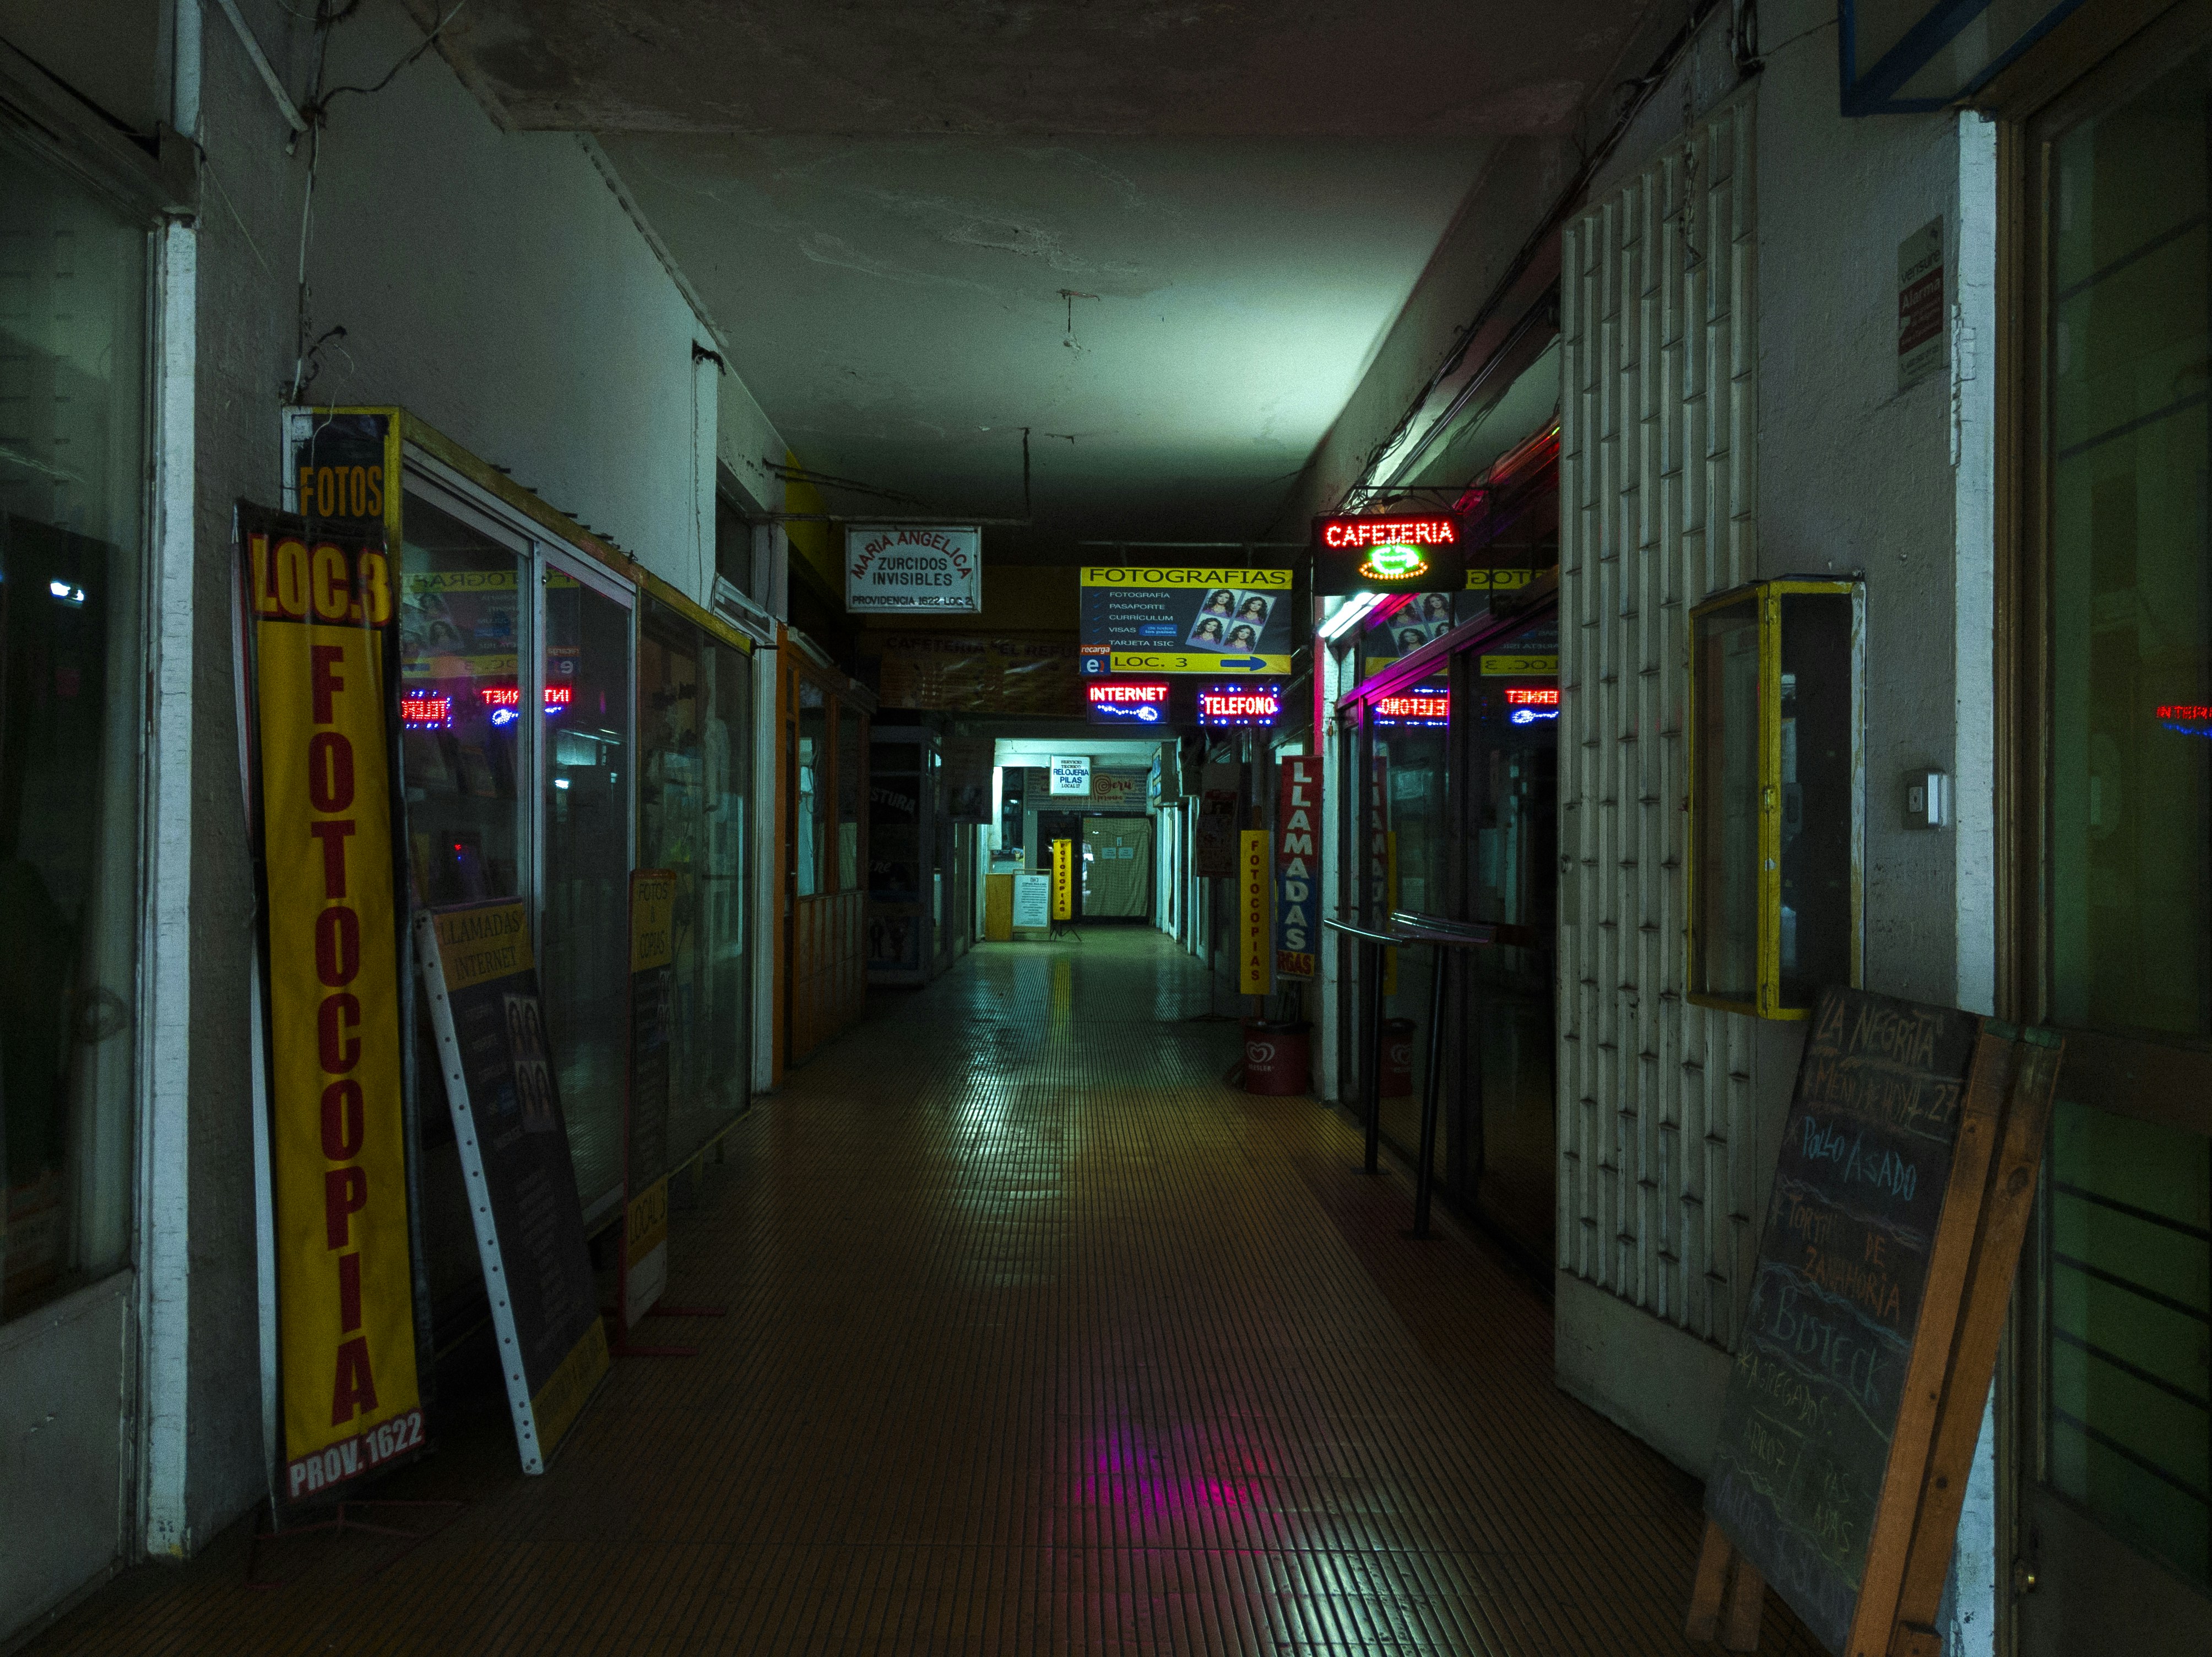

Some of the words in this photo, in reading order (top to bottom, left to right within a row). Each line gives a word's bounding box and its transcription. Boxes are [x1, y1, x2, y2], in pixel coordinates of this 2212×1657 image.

[1902, 278, 1940, 312] Alarma
[300, 466, 382, 517] FOTOS
[1326, 522, 1454, 547] CAFETERIA
[852, 535, 892, 580] MARIA
[897, 530, 972, 580] ANGELICA
[879, 557, 947, 571] ZURCIDOS
[872, 573, 952, 586] INVISIBLES
[1089, 568, 1286, 584] FOTOGRAFIAS
[852, 596, 915, 605] PROVIDENCIA
[918, 597, 940, 605] 1622
[886, 637, 985, 654] CAFETERIA
[1081, 646, 1110, 654] recarga
[1114, 657, 1164, 667] LOC.
[1175, 658, 1188, 667] 3
[1090, 687, 1167, 701] INTERNET
[1205, 697, 1275, 714] TELEFONO
[1283, 762, 1313, 950] LLAMADAS
[639, 882, 668, 901] FOTOS
[1250, 841, 1259, 980] FOTOCOPIAS
[440, 910, 520, 945] LLAMADAS
[454, 946, 517, 981] INTERNET
[309, 645, 378, 1426] FOTOCOPIA
[1844, 1130, 1917, 1201] ASADO
[290, 1442, 362, 1498] PROV.
[366, 1412, 423, 1465] 1622
